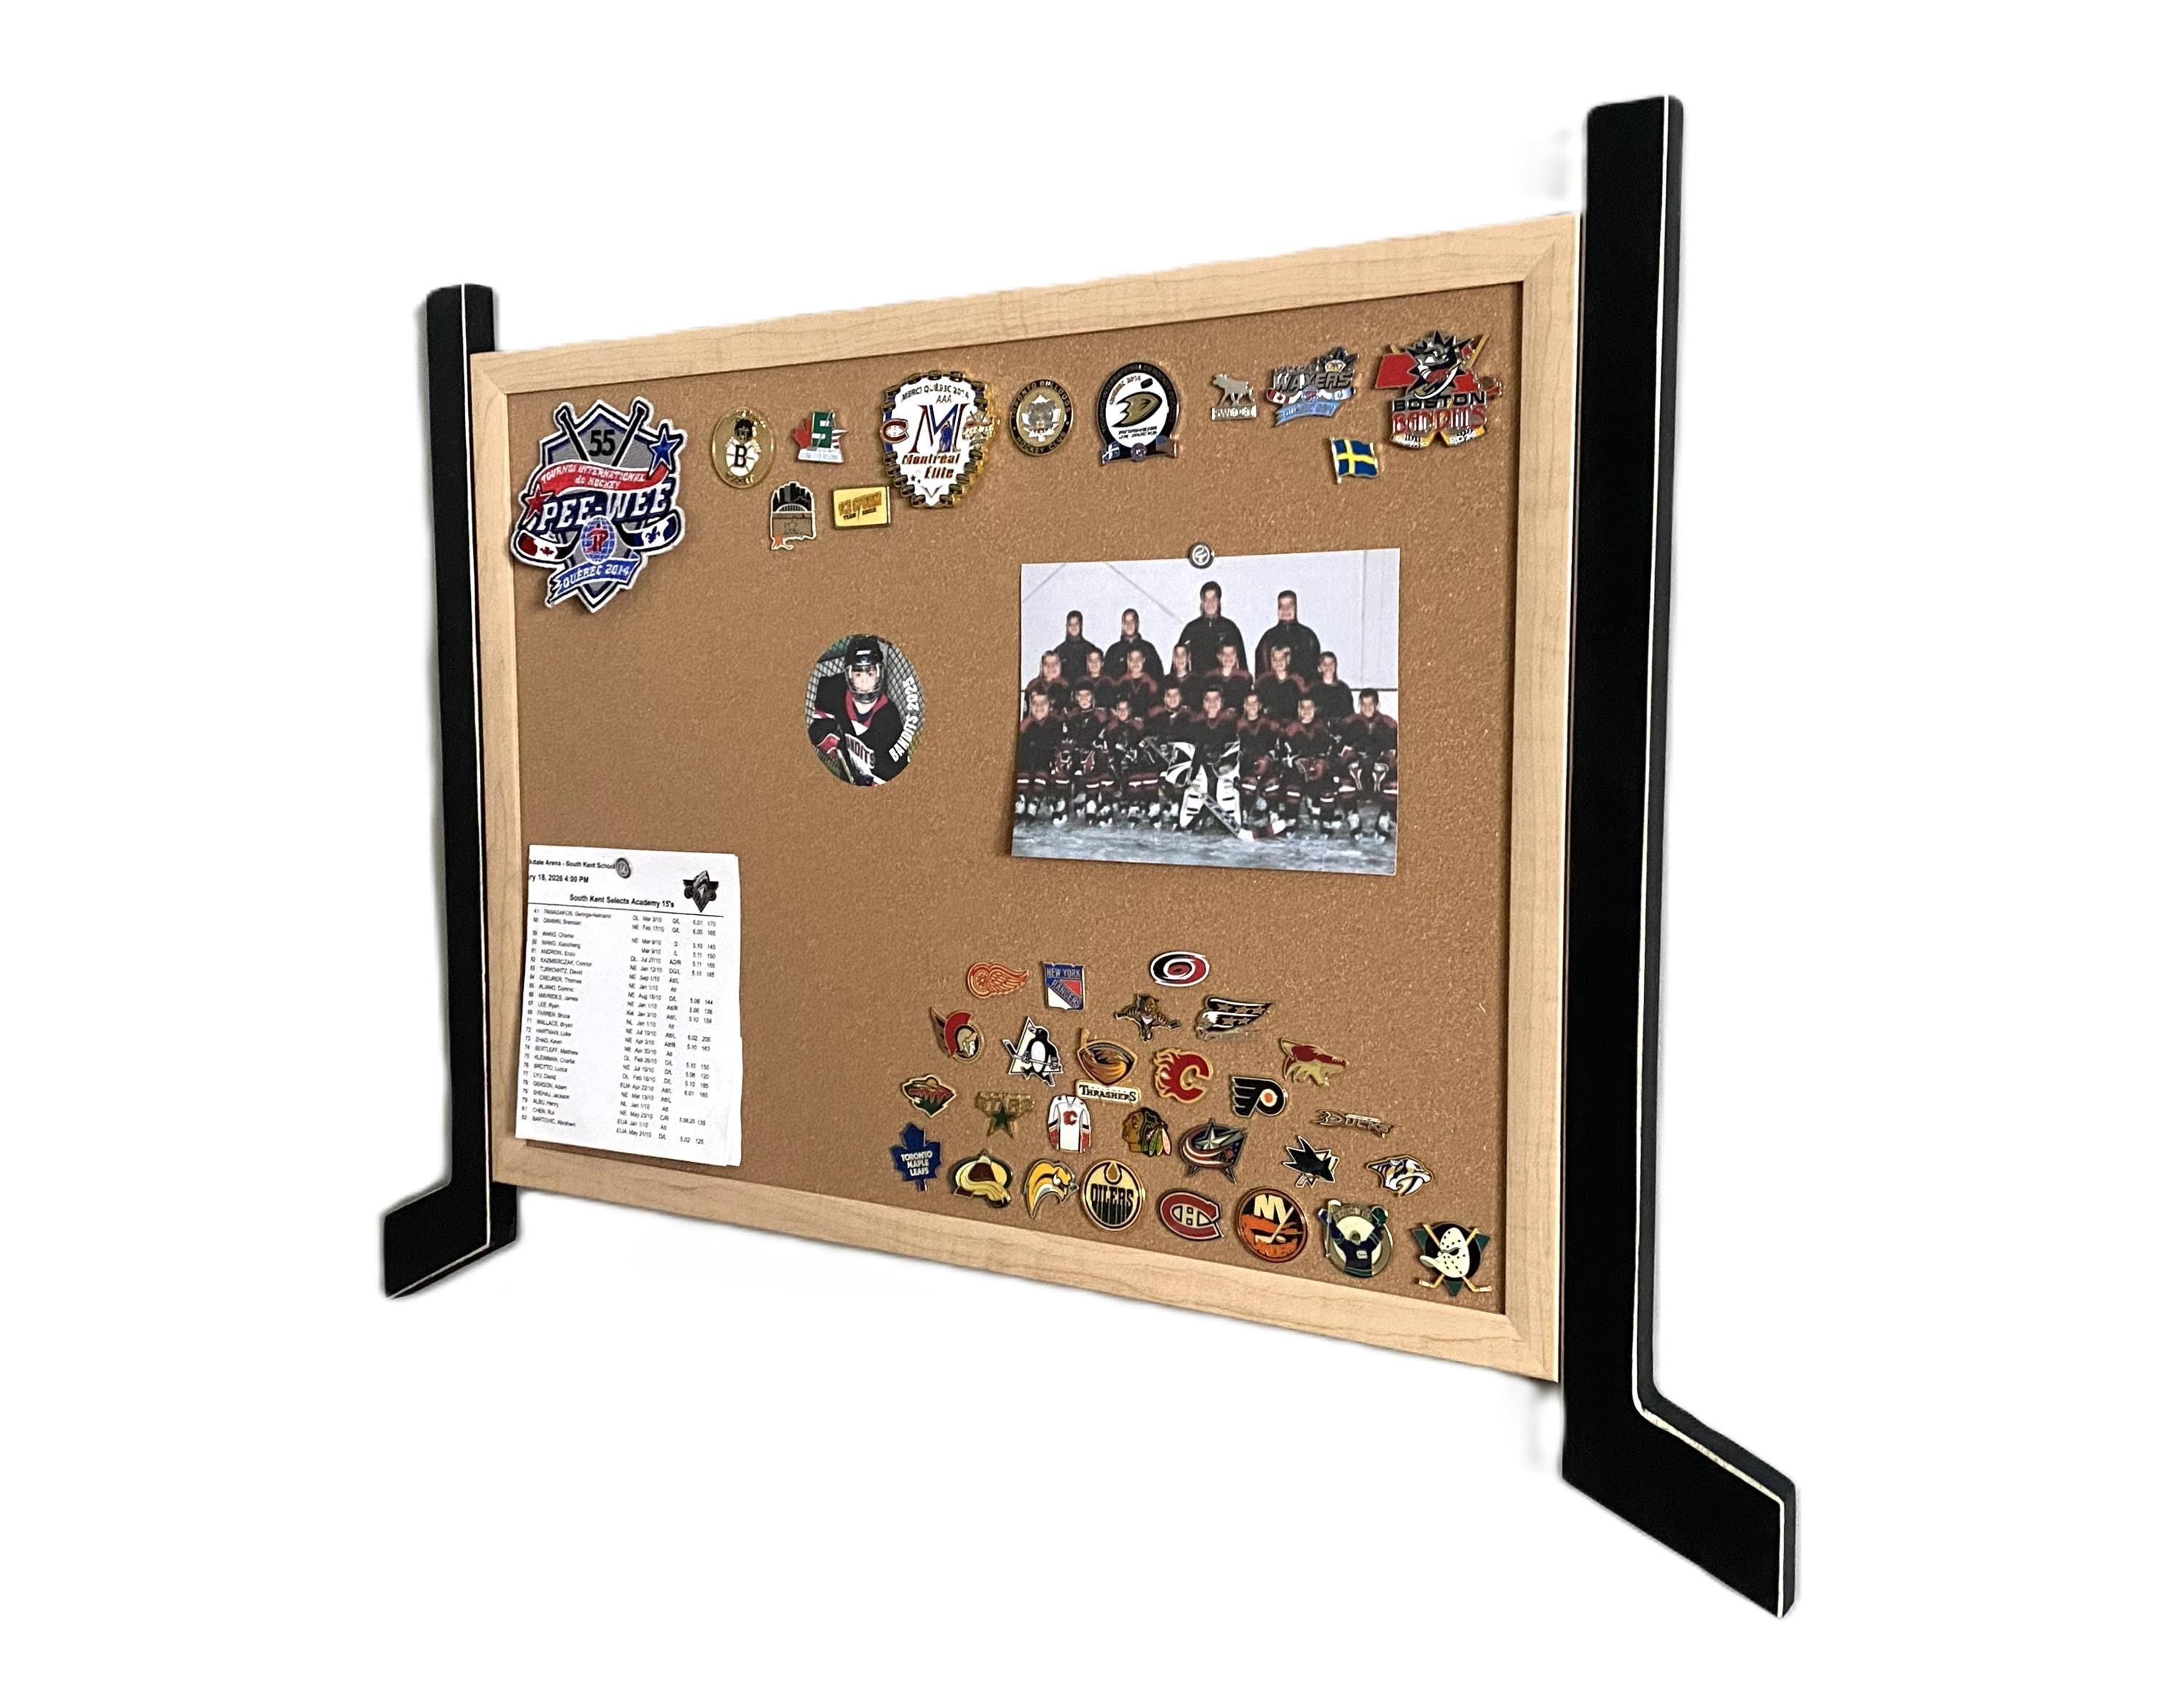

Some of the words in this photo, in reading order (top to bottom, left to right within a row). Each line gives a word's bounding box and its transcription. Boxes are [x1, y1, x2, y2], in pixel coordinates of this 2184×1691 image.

[936, 394, 952, 404] AAA
[1392, 392, 1486, 412] BOSTON
[588, 429, 616, 456] 55
[734, 443, 748, 467] B
[578, 464, 646, 482] INTERNATIONAL
[588, 477, 621, 489] HOCKEY
[537, 483, 672, 531] PEE-WEE
[563, 563, 604, 588] QUÉBEC
[604, 563, 630, 576] 2014
[903, 675, 920, 711] 2025
[889, 714, 919, 762] BANDITS
[579, 876, 589, 884] PM
[569, 893, 588, 902] South
[590, 895, 605, 903] Kent
[606, 896, 630, 905] Selects
[631, 898, 660, 908] Academy
[1047, 967, 1061, 977] NEW
[1063, 968, 1081, 979] YORK
[1051, 979, 1080, 1009] RANGERS
[629, 1110, 640, 1118] May
[901, 1150, 933, 1162] TORONTO
[907, 1158, 929, 1168] MAPLE
[909, 1167, 929, 1176] LEAFS
[1091, 1184, 1133, 1219] OILERS
